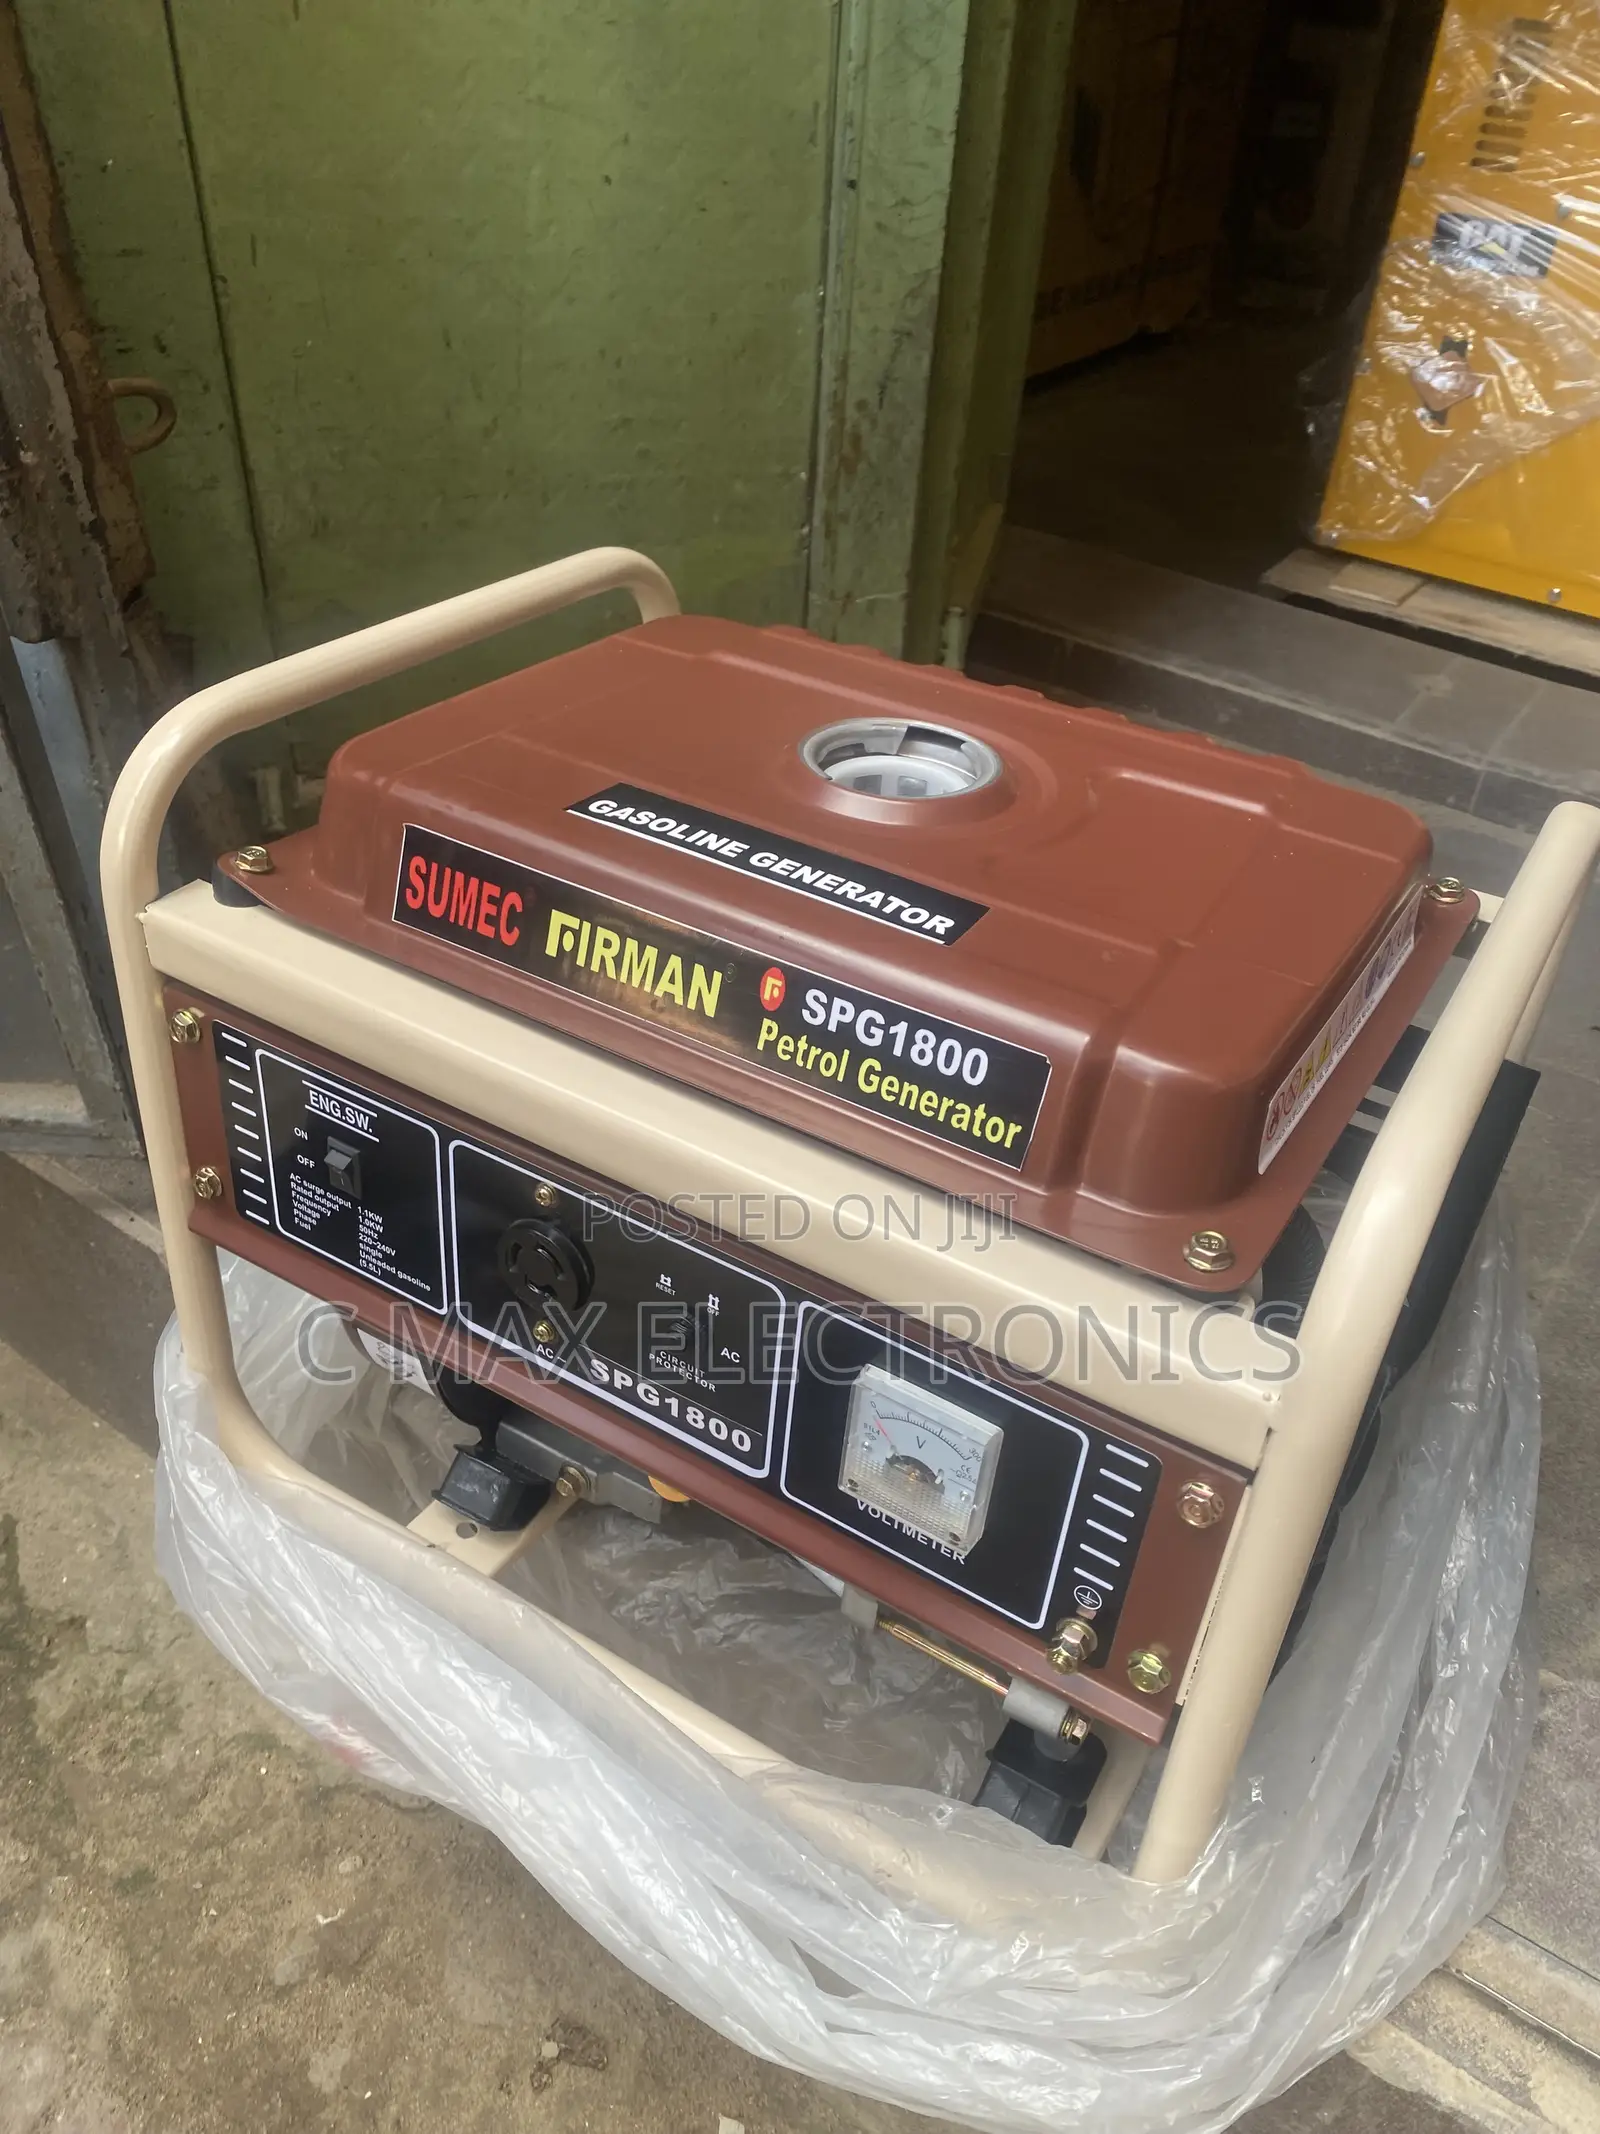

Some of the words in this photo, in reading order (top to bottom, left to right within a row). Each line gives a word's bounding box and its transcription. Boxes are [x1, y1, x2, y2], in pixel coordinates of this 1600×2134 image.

[587, 799, 751, 858] GASOLINE
[749, 851, 956, 935] GENERATOR
[405, 855, 523, 946] SUMEC
[545, 909, 723, 1018] FIRMAN
[801, 988, 989, 1086] SPG1800
[756, 1018, 849, 1082] Petrol
[857, 1057, 1022, 1149] Generator
[294, 1127, 308, 1141] ON
[308, 1089, 373, 1133] ENG.SW.
[297, 1154, 315, 1169] OFF
[290, 1172, 301, 1184] AC
[303, 1180, 325, 1196] surge
[326, 1189, 352, 1209] output
[357, 1206, 383, 1223] 1.1KW
[290, 1181, 313, 1198] Rated
[314, 1193, 340, 1212] output
[358, 1215, 384, 1233] 1.0KW
[291, 1190, 331, 1217] Frequency
[359, 1224, 379, 1240] 50Hz
[292, 1199, 321, 1219] Voltage
[293, 1208, 317, 1226] Phase
[359, 1242, 383, 1259] single
[294, 1217, 312, 1231] Fuel
[359, 1250, 396, 1274] Unleaded
[397, 1269, 431, 1291] gasoline
[656, 1282, 676, 1296] RESET
[706, 1306, 720, 1317] OFF
[536, 1343, 554, 1360] AC
[649, 1353, 716, 1392] PROTECTOR
[660, 1351, 705, 1378] CIRCUIT
[720, 1347, 740, 1363] AC
[590, 1358, 752, 1452] SPG1800
[916, 1435, 926, 1449] V
[855, 1499, 967, 1565] VOLTMETER
